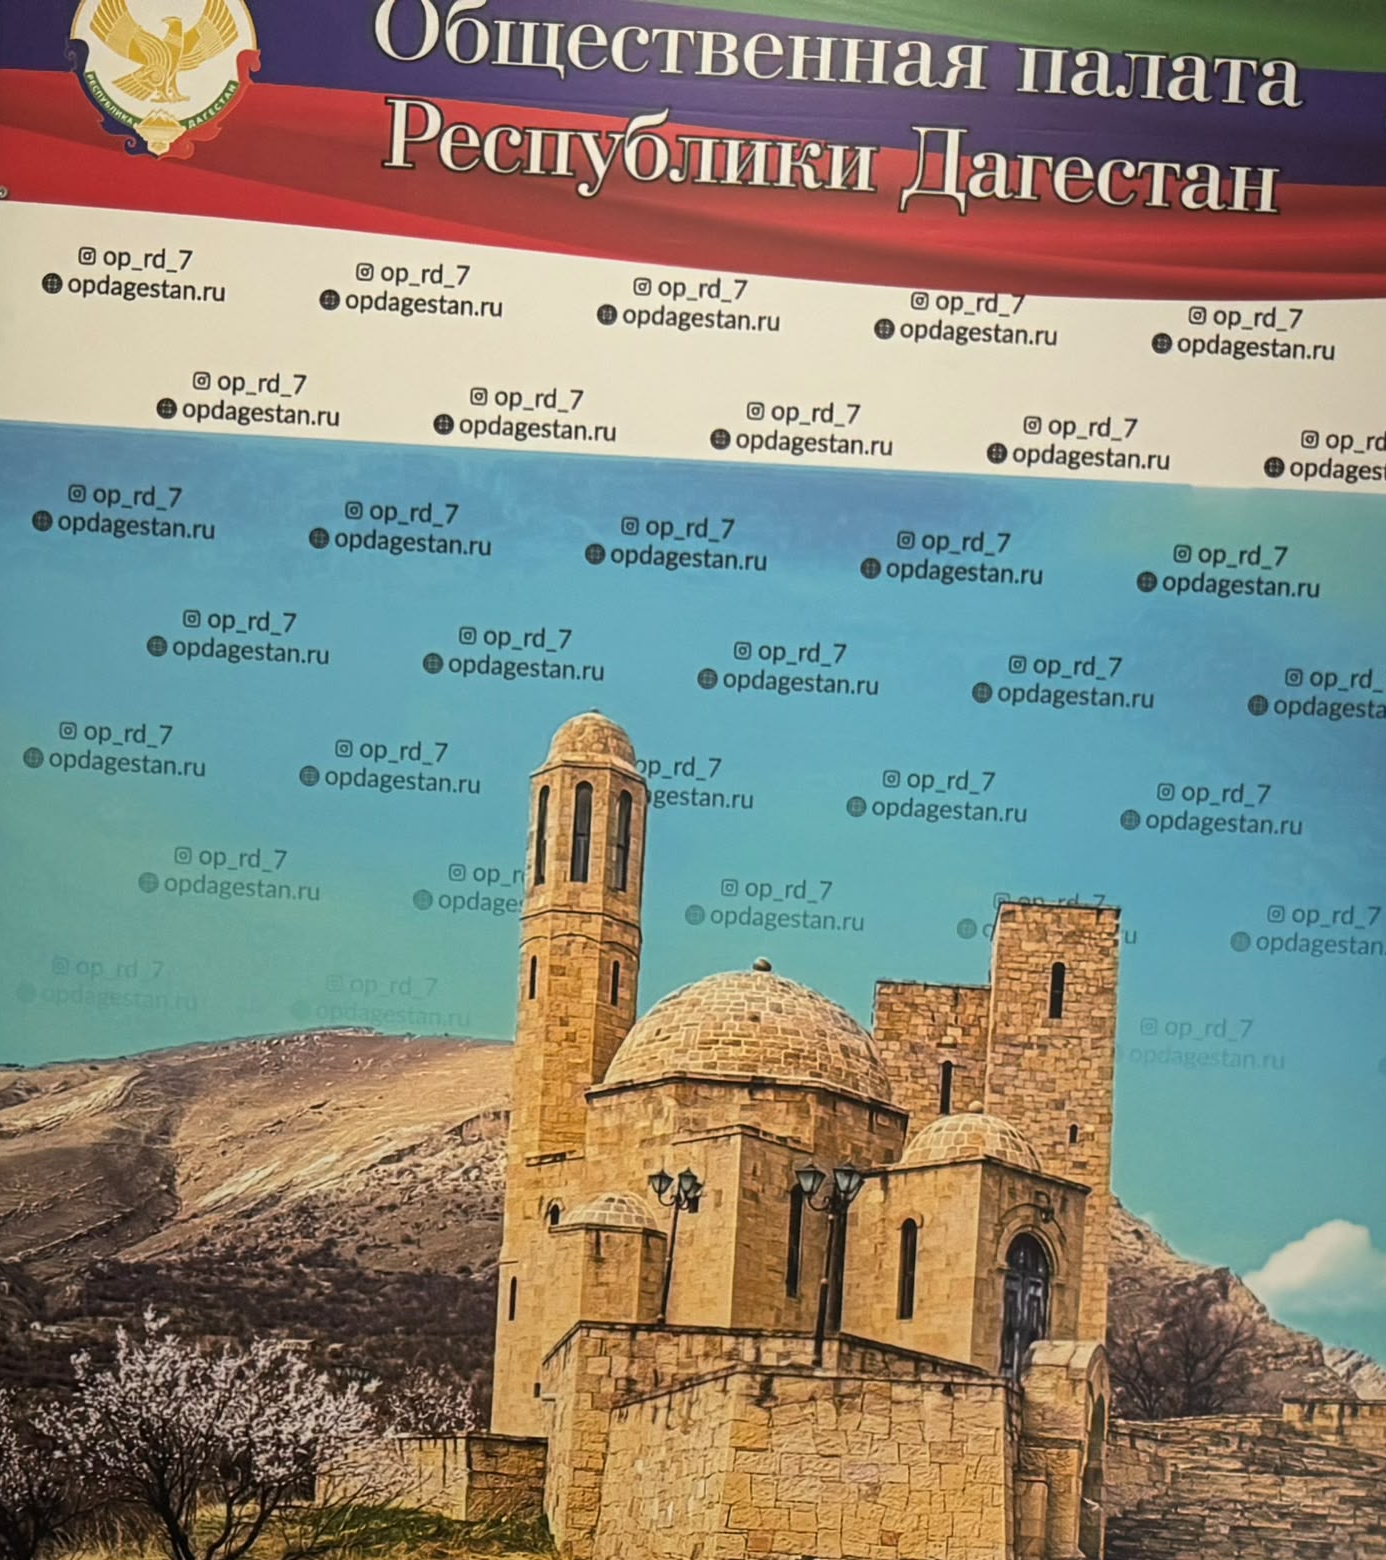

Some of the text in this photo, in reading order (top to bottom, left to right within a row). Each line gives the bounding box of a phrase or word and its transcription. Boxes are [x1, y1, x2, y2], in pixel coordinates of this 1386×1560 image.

[373, 0, 1304, 108] Общественная палата
[188, 84, 238, 129] ДАГЕСТАН
[382, 98, 1280, 215] Республики Дагестан
[103, 248, 193, 273] op_rd_7
[68, 274, 225, 301] opdagestan.ru
[381, 264, 470, 288] op_rd_7
[346, 290, 502, 317] opdagestan.ru
[658, 278, 748, 303] op_rd_7
[623, 305, 780, 331] opdagestan.ru
[936, 295, 1024, 317] op_rd_7
[900, 319, 1057, 346] opdagestan.ru
[1214, 307, 1303, 332] op_rd_7
[1178, 334, 1335, 360] opdagestan.ru
[218, 373, 307, 397] op_rd_7
[183, 400, 339, 426] opdagestan.ru
[495, 388, 584, 413] op_rd_7
[771, 402, 861, 427] op_rd_7
[460, 415, 616, 442] opdagestan.ru
[1048, 417, 1138, 441] op_rd_7
[736, 429, 892, 456] opdagestan.ru
[1013, 443, 1169, 470] opdagestan.ru
[93, 486, 182, 511] op_rd_7
[58, 512, 215, 539] opdagestan.ru
[370, 502, 459, 527] op_rd_7
[335, 529, 491, 556] opdagestan.ru
[646, 517, 735, 543] op_rd_7
[922, 531, 1011, 556] op_rd_7
[611, 544, 767, 571] opdagestan.ru
[1198, 544, 1288, 570] op_rd_7
[887, 558, 1043, 585] opdagestan.ru
[1163, 572, 1320, 598] opdagestan.ru
[208, 611, 297, 636] op_rd_7
[173, 637, 329, 665] opdagestan.ru
[484, 627, 572, 652] op_rd_7
[449, 654, 604, 681] opdagestan.ru
[758, 642, 847, 667] op_rd_7
[1033, 656, 1122, 680] op_rd_7
[723, 669, 878, 695] opdagestan.ru
[998, 683, 1154, 709] opdagestan.ru
[84, 723, 173, 748] op_rd_7
[49, 749, 205, 777] opdagestan.ru
[360, 741, 448, 766] op_rd_7
[325, 767, 480, 794] opdagestan.ru
[907, 770, 995, 795] op_rd_7
[648, 788, 755, 810] gestan.ru
[1182, 783, 1271, 807] op_rd_7
[872, 797, 1027, 823] opdagestan.ru
[1146, 810, 1302, 836] opdagestan.ru
[199, 848, 287, 873] op_rd_7
[164, 874, 319, 901] opdagestan.ru
[745, 880, 832, 904] op_rd_7
[710, 906, 864, 931] opdagestan.ru
[1292, 905, 1381, 929] op_rd_7
